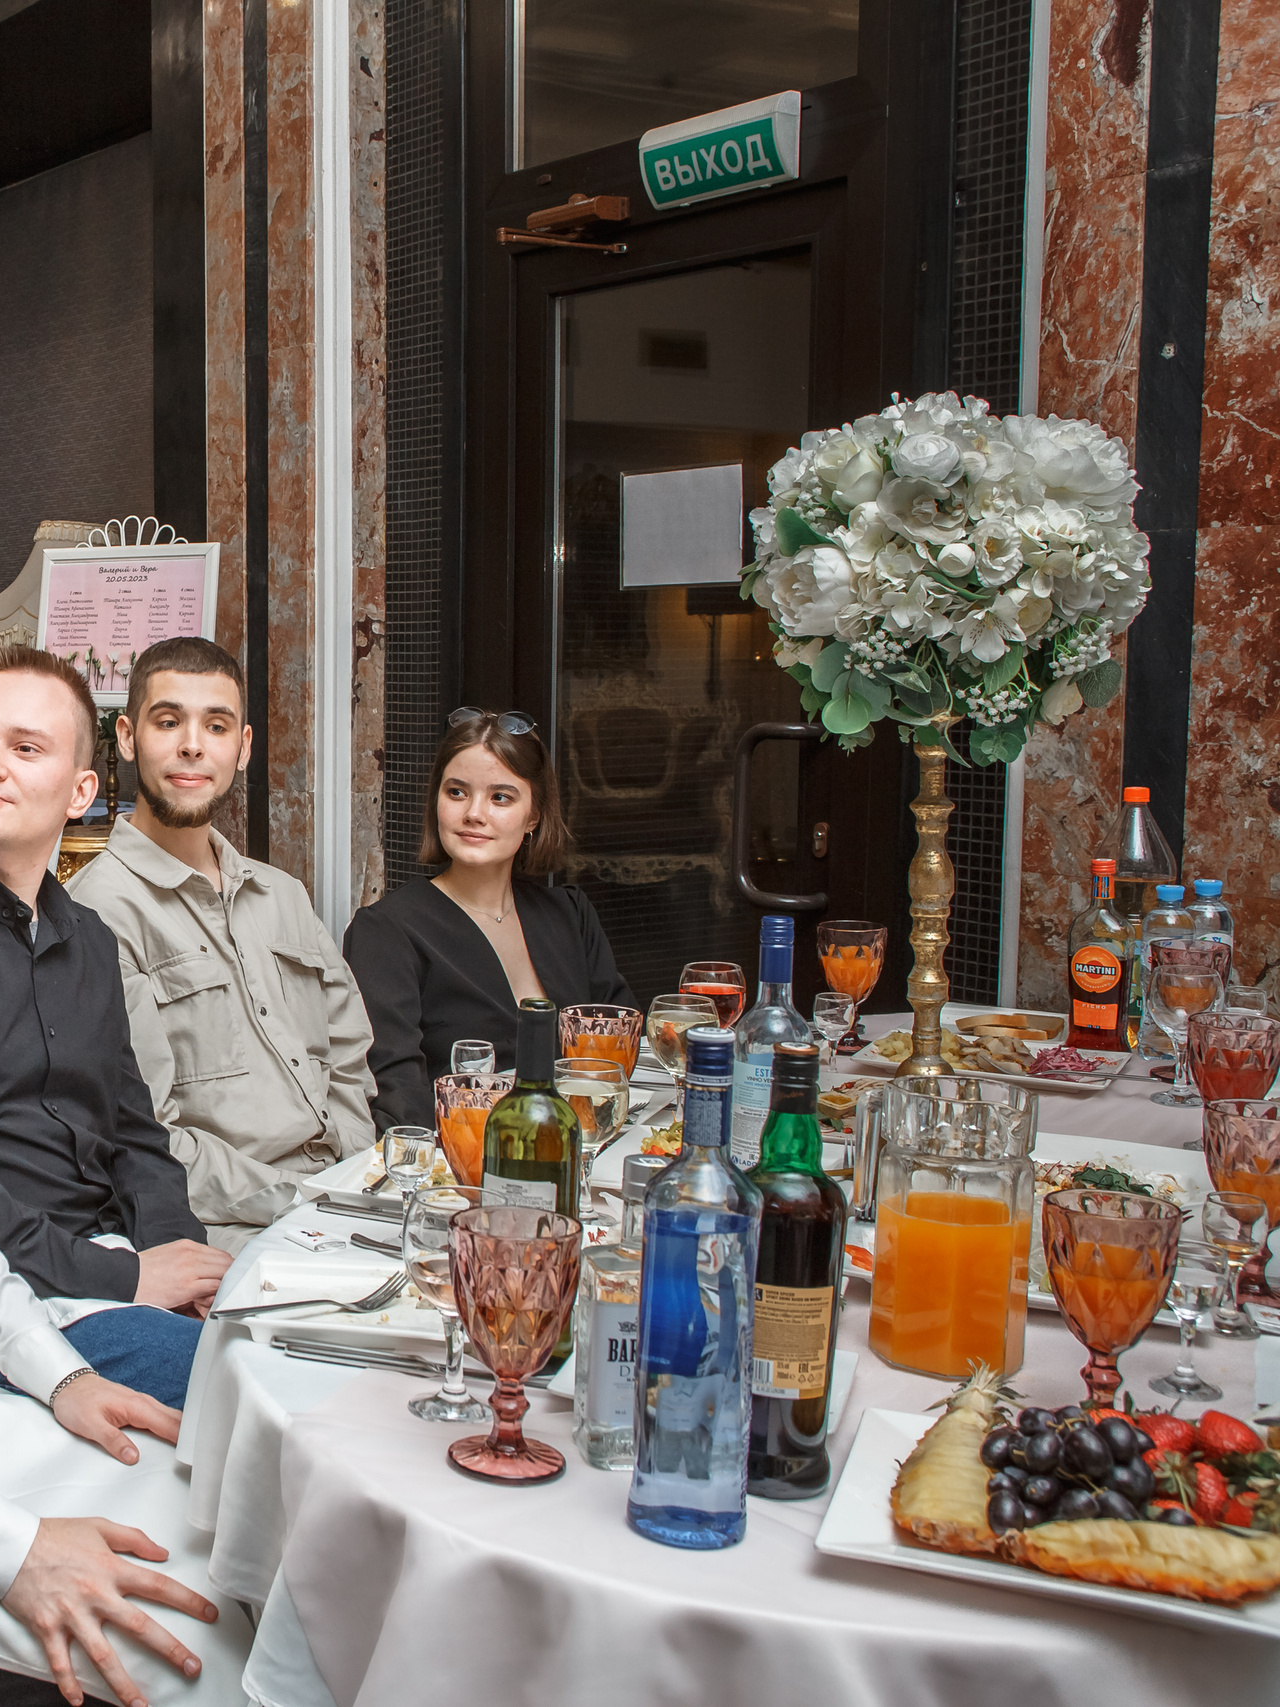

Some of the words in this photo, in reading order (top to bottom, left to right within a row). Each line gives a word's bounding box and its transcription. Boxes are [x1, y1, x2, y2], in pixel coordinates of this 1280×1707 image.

[654, 133, 773, 191] ВЫХОД
[98, 566, 130, 574] Валерий
[140, 565, 158, 574] Вера
[1076, 964, 1116, 975] MARTINI
